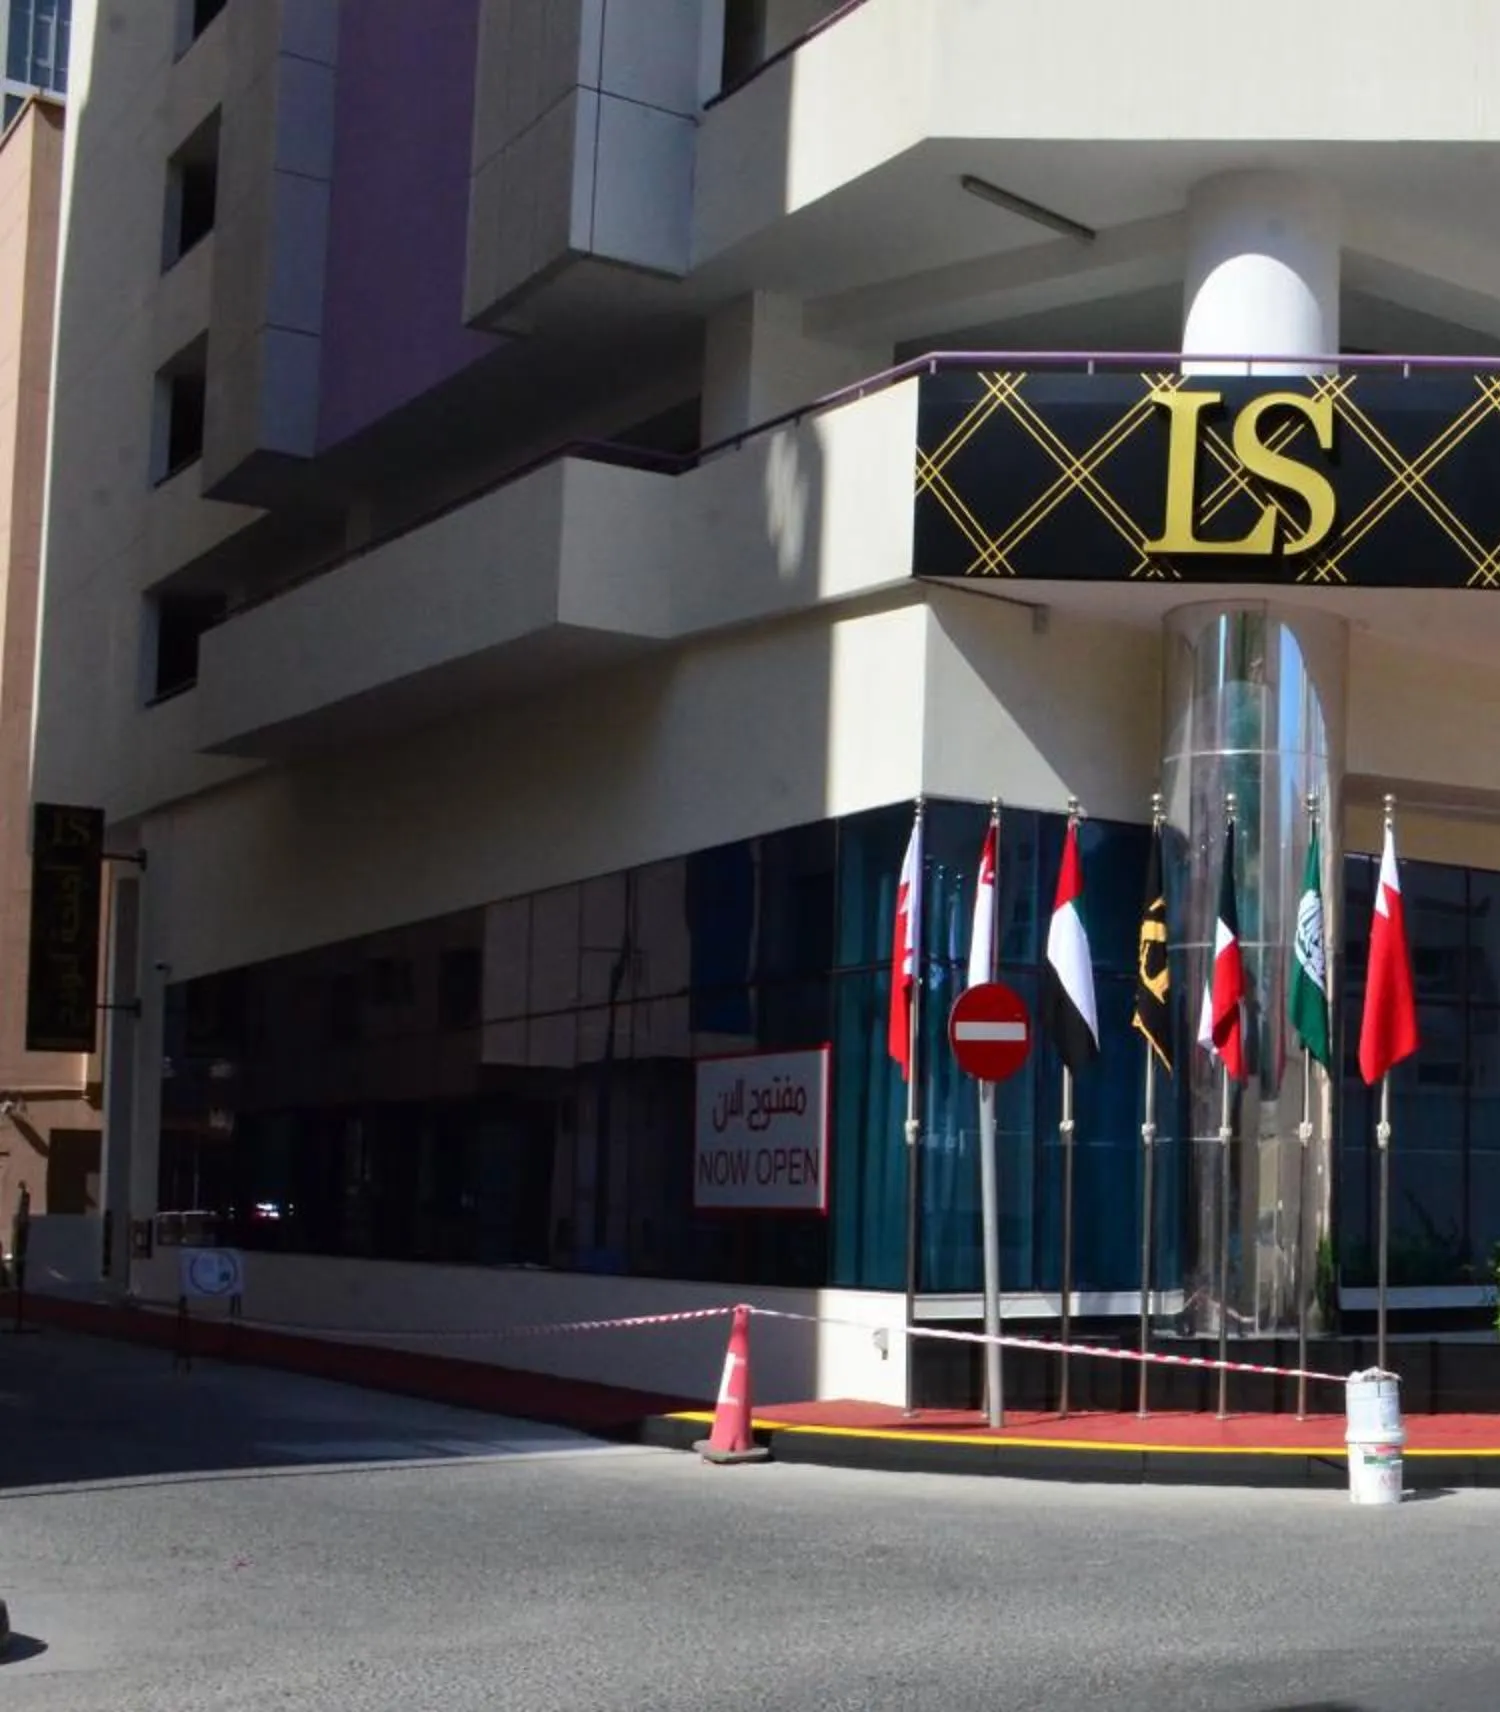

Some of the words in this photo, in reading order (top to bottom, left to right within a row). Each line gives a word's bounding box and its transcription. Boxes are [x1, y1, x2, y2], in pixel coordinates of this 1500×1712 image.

[1143, 390, 1337, 556] LS
[747, 1075, 807, 1133] مفتوح
[700, 1150, 750, 1186] NOW
[755, 1148, 819, 1186] OPEN
